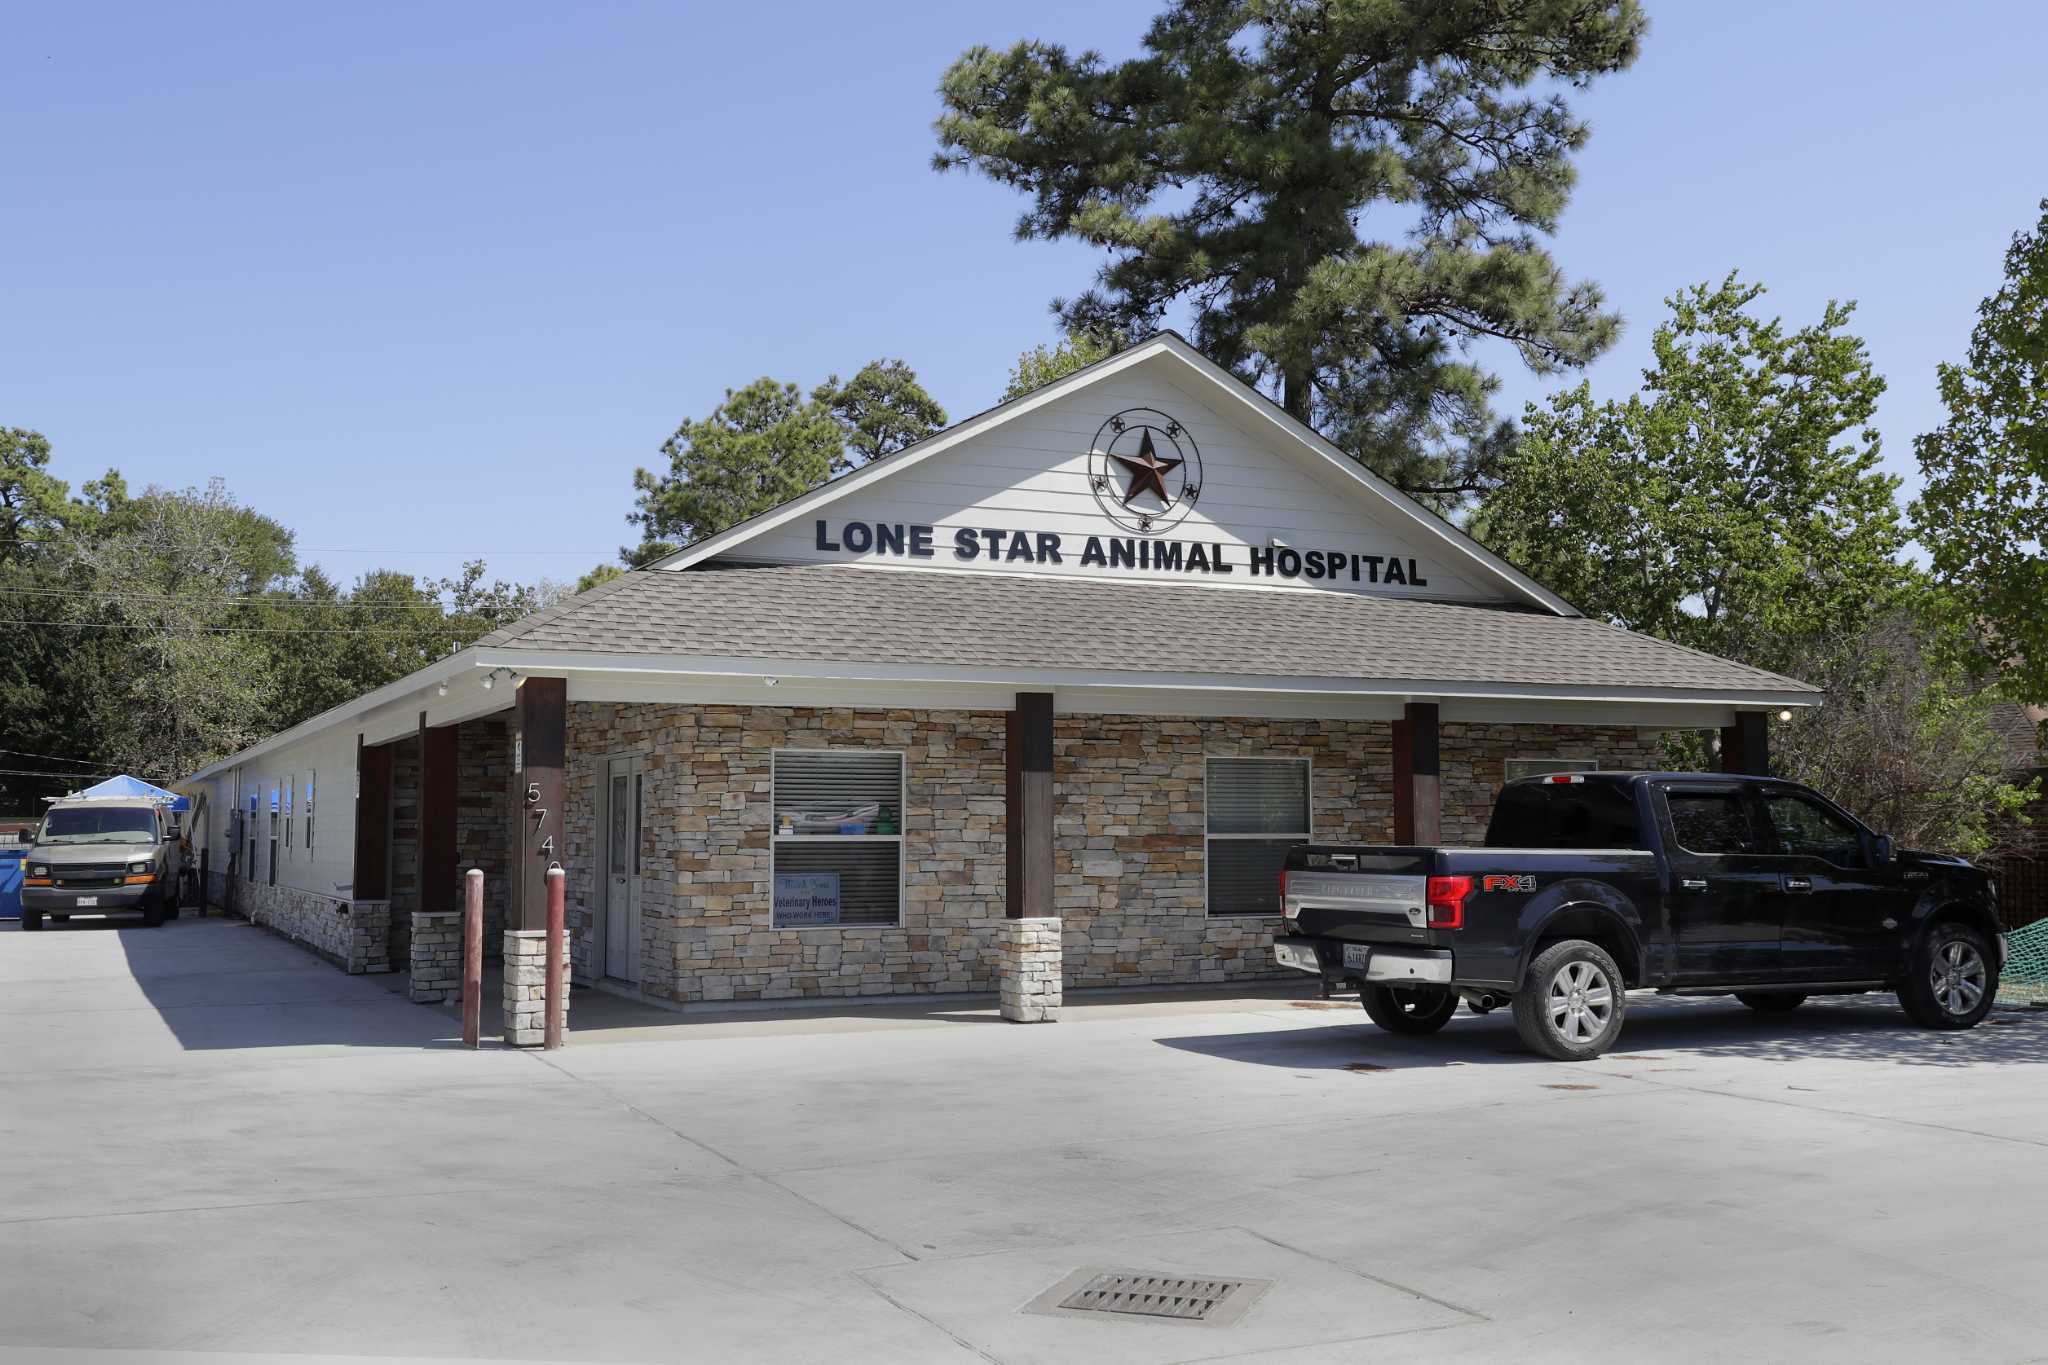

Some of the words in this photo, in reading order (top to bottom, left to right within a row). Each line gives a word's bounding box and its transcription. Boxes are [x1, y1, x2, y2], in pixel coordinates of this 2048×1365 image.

[816, 520, 934, 556] LONE
[955, 528, 1062, 563] STAR
[1080, 536, 1233, 572] ANIMAL
[1250, 547, 1427, 586] HOSPITAL
[1482, 875, 1536, 892] FX4
[774, 896, 811, 910] Veterinary
[812, 896, 837, 907] Heroes
